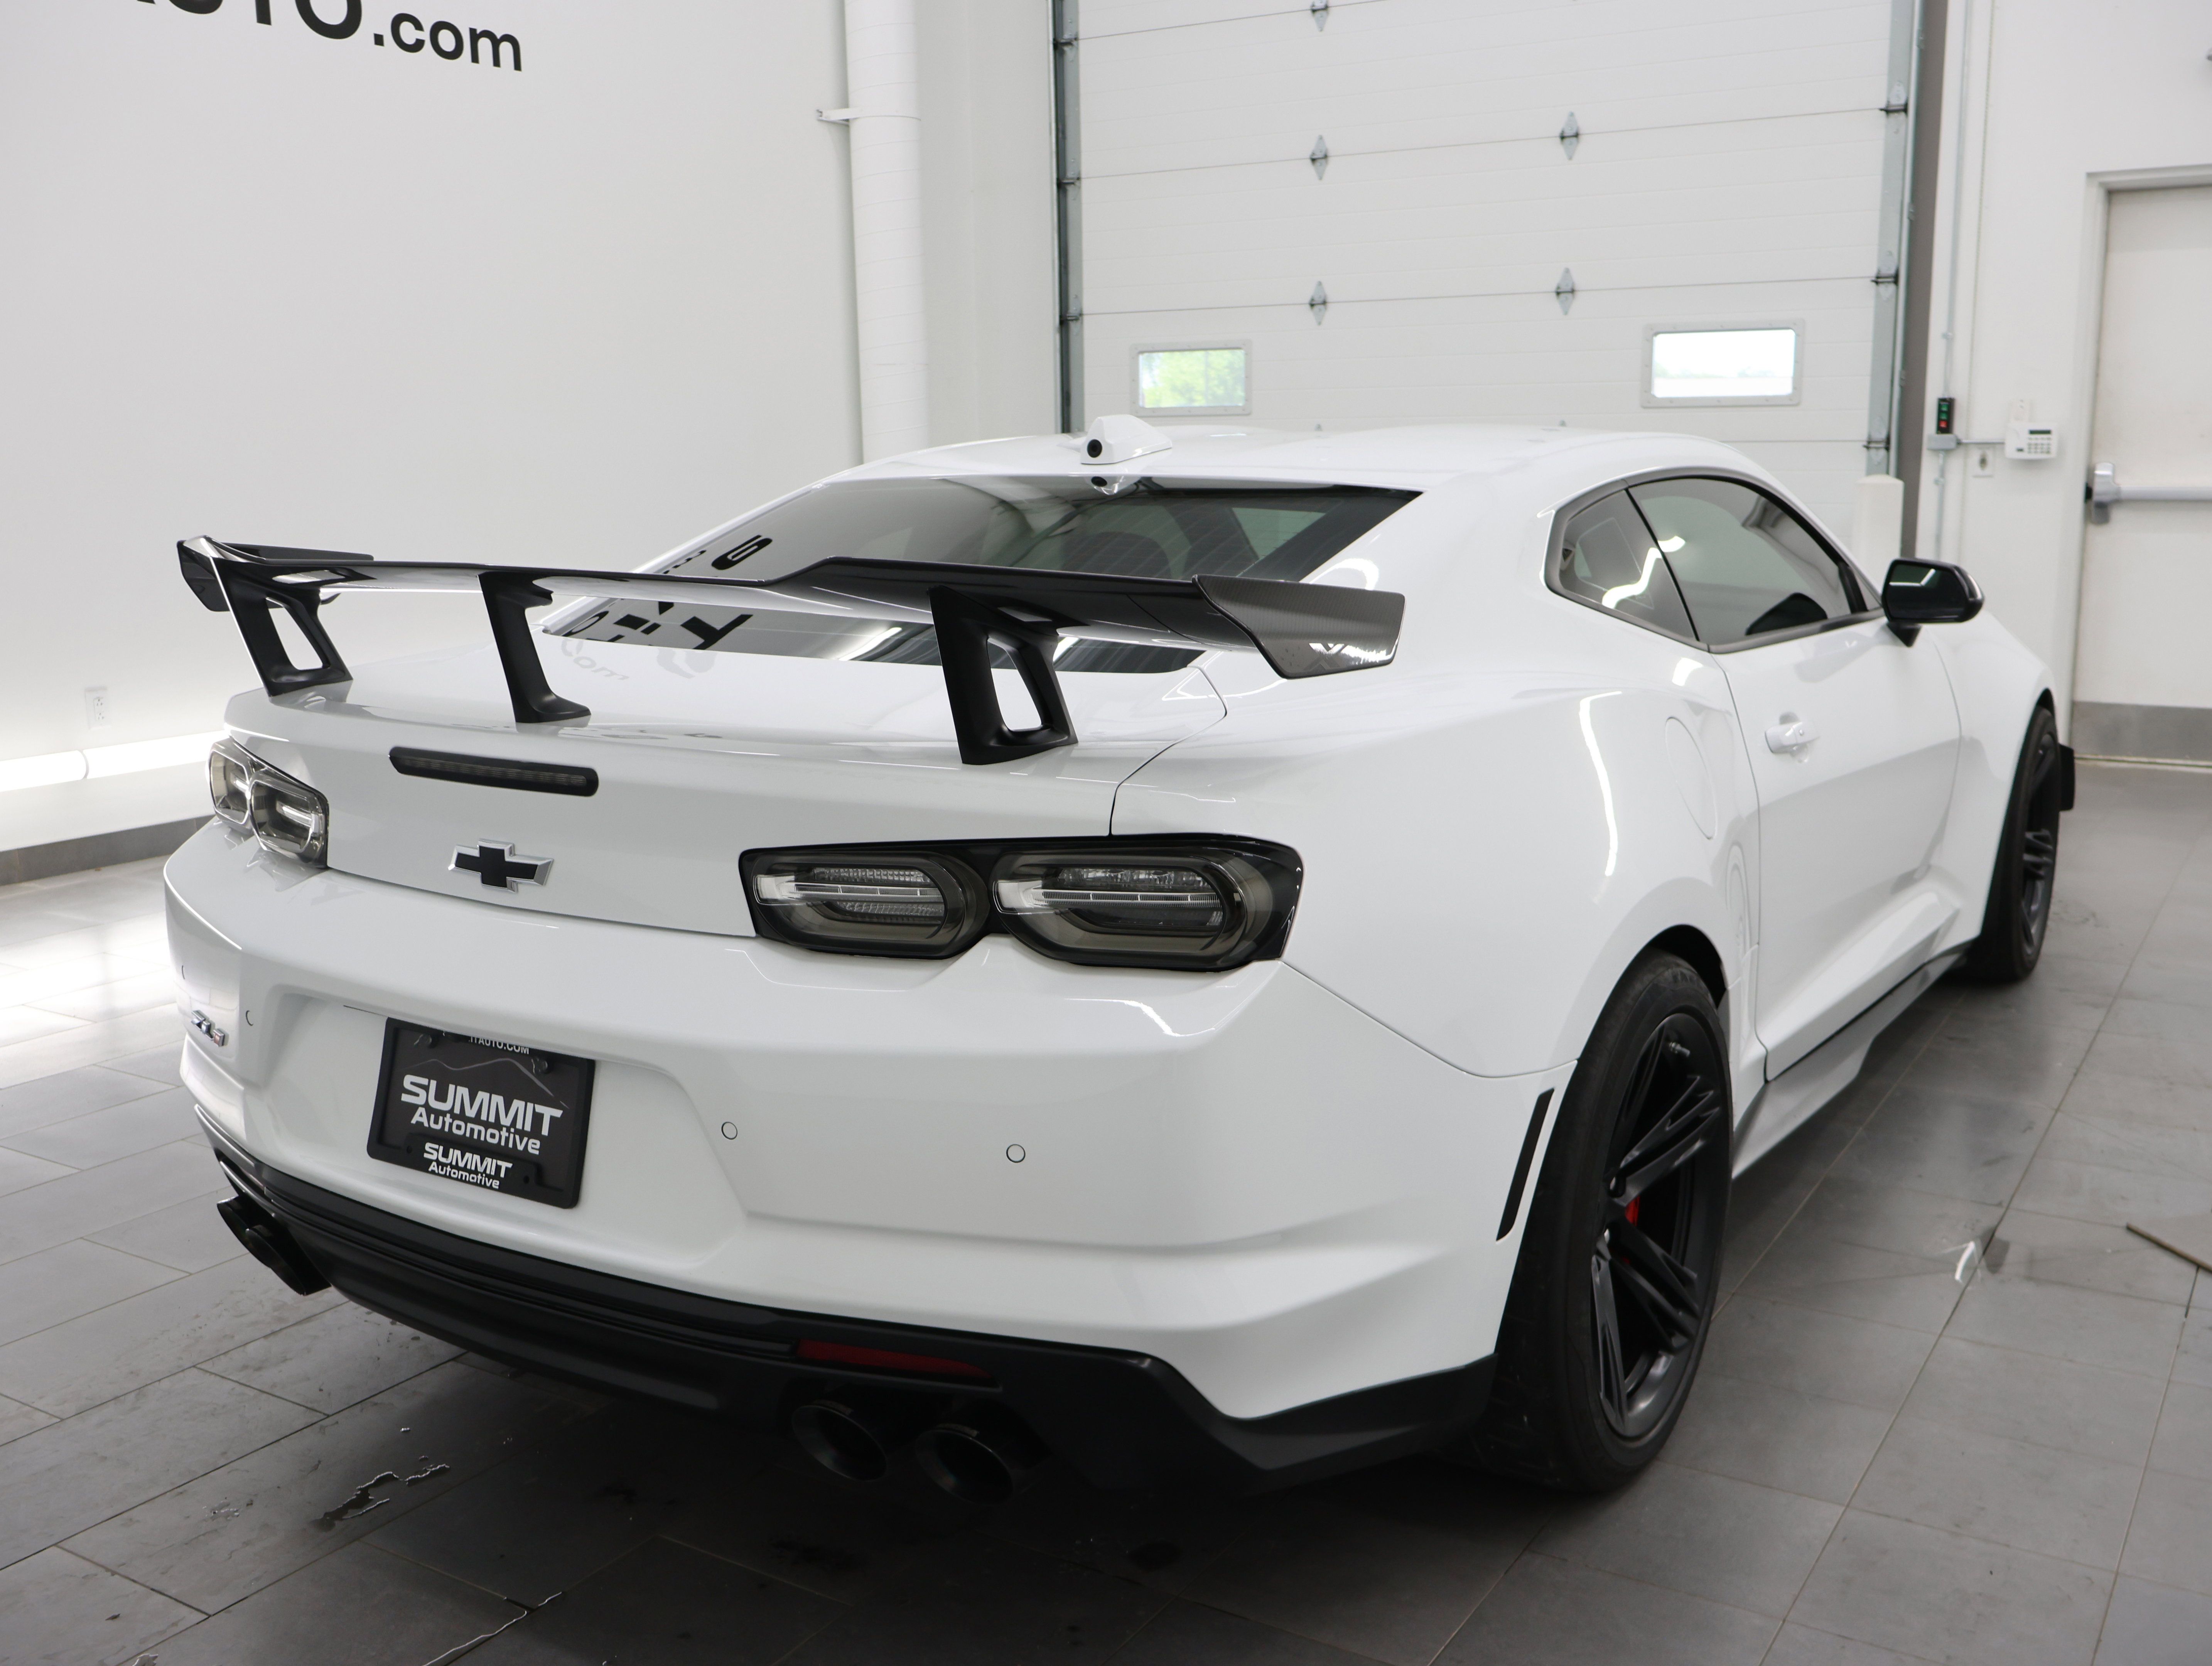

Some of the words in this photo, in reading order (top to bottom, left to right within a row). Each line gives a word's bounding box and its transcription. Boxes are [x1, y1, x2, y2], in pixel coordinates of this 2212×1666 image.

[401, 1074, 563, 1136] SUMMIT
[410, 1106, 540, 1155] Automotive
[424, 1142, 513, 1178] SUMMIT
[428, 1161, 499, 1189] Automotive
